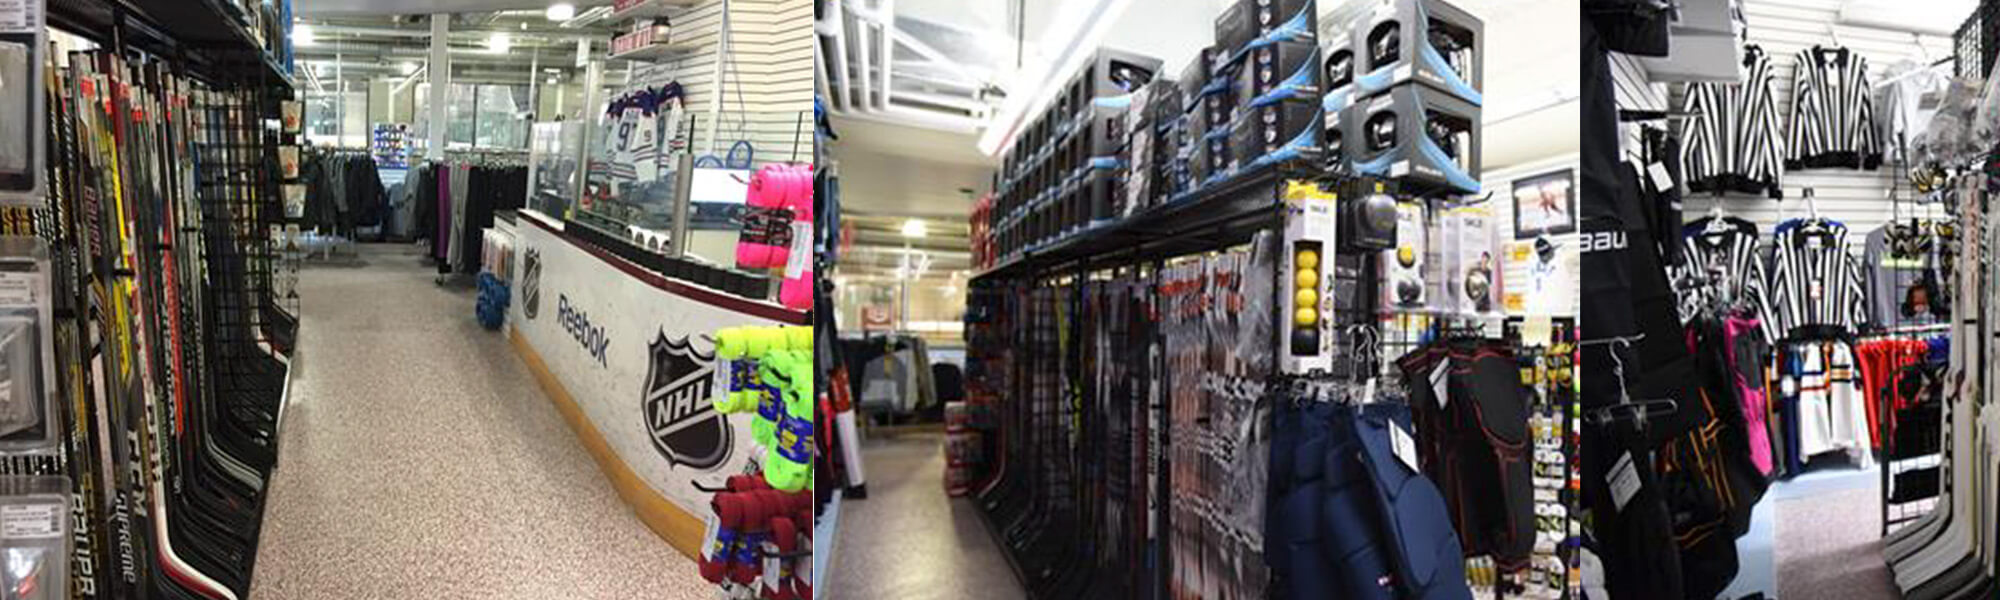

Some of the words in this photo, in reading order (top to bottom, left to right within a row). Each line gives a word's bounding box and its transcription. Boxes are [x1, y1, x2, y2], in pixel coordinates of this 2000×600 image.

[557, 293, 610, 369] Reebok
[655, 379, 713, 429] NHL
[127, 427, 148, 517] CCM
